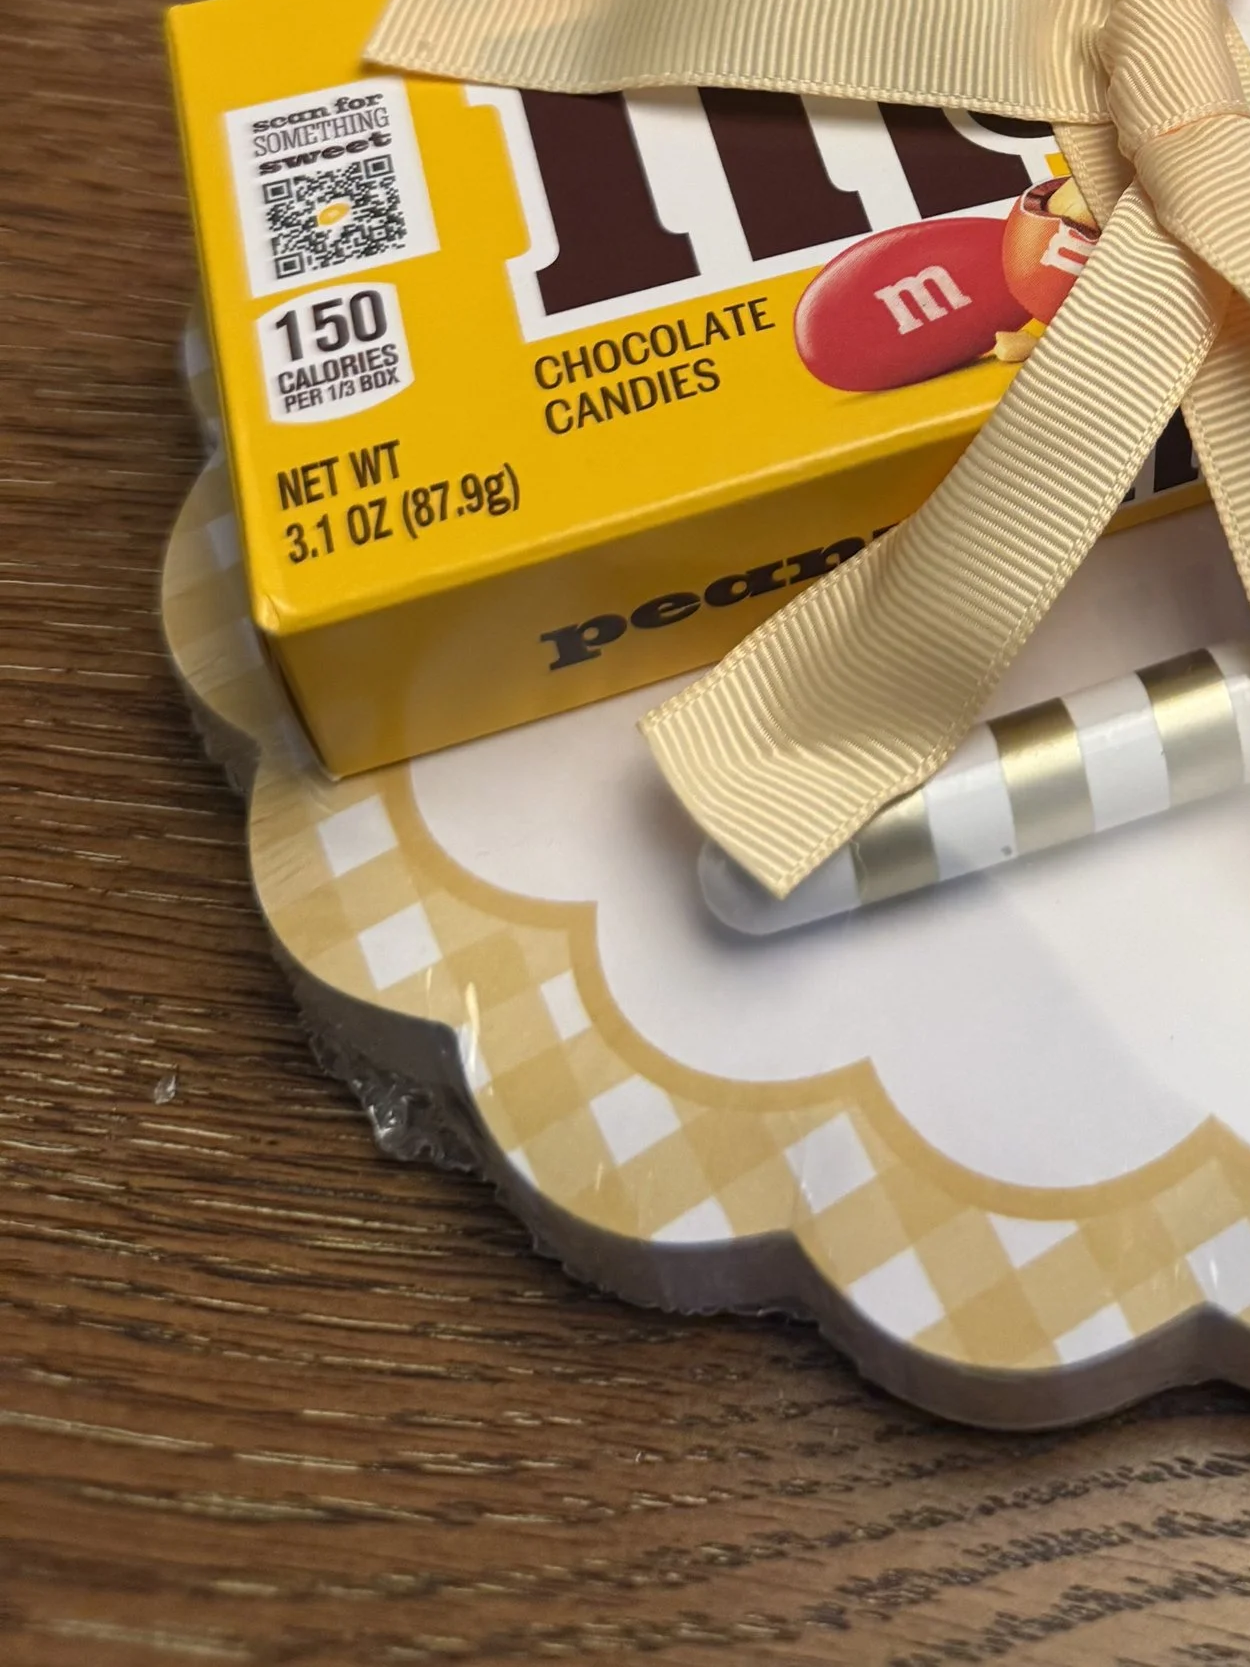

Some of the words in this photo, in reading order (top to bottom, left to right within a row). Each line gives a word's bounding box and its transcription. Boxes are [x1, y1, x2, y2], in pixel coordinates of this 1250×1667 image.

[253, 106, 331, 134] scan
[334, 93, 384, 114] for
[253, 106, 391, 158] SOMETHING
[258, 131, 393, 176] sweet
[275, 289, 388, 362] 150
[874, 264, 973, 335] m
[277, 343, 400, 395] CALORIES
[533, 296, 775, 390] CHOCOLATE
[284, 388, 324, 414] PER
[329, 380, 356, 402] 1/3
[361, 368, 401, 393] BOX
[544, 357, 721, 435] CANDIES
[277, 456, 340, 511] NET
[348, 439, 401, 489] WT
[285, 514, 335, 564] 3.1
[346, 497, 394, 547] OZ
[402, 462, 521, 540] (87.9g)
